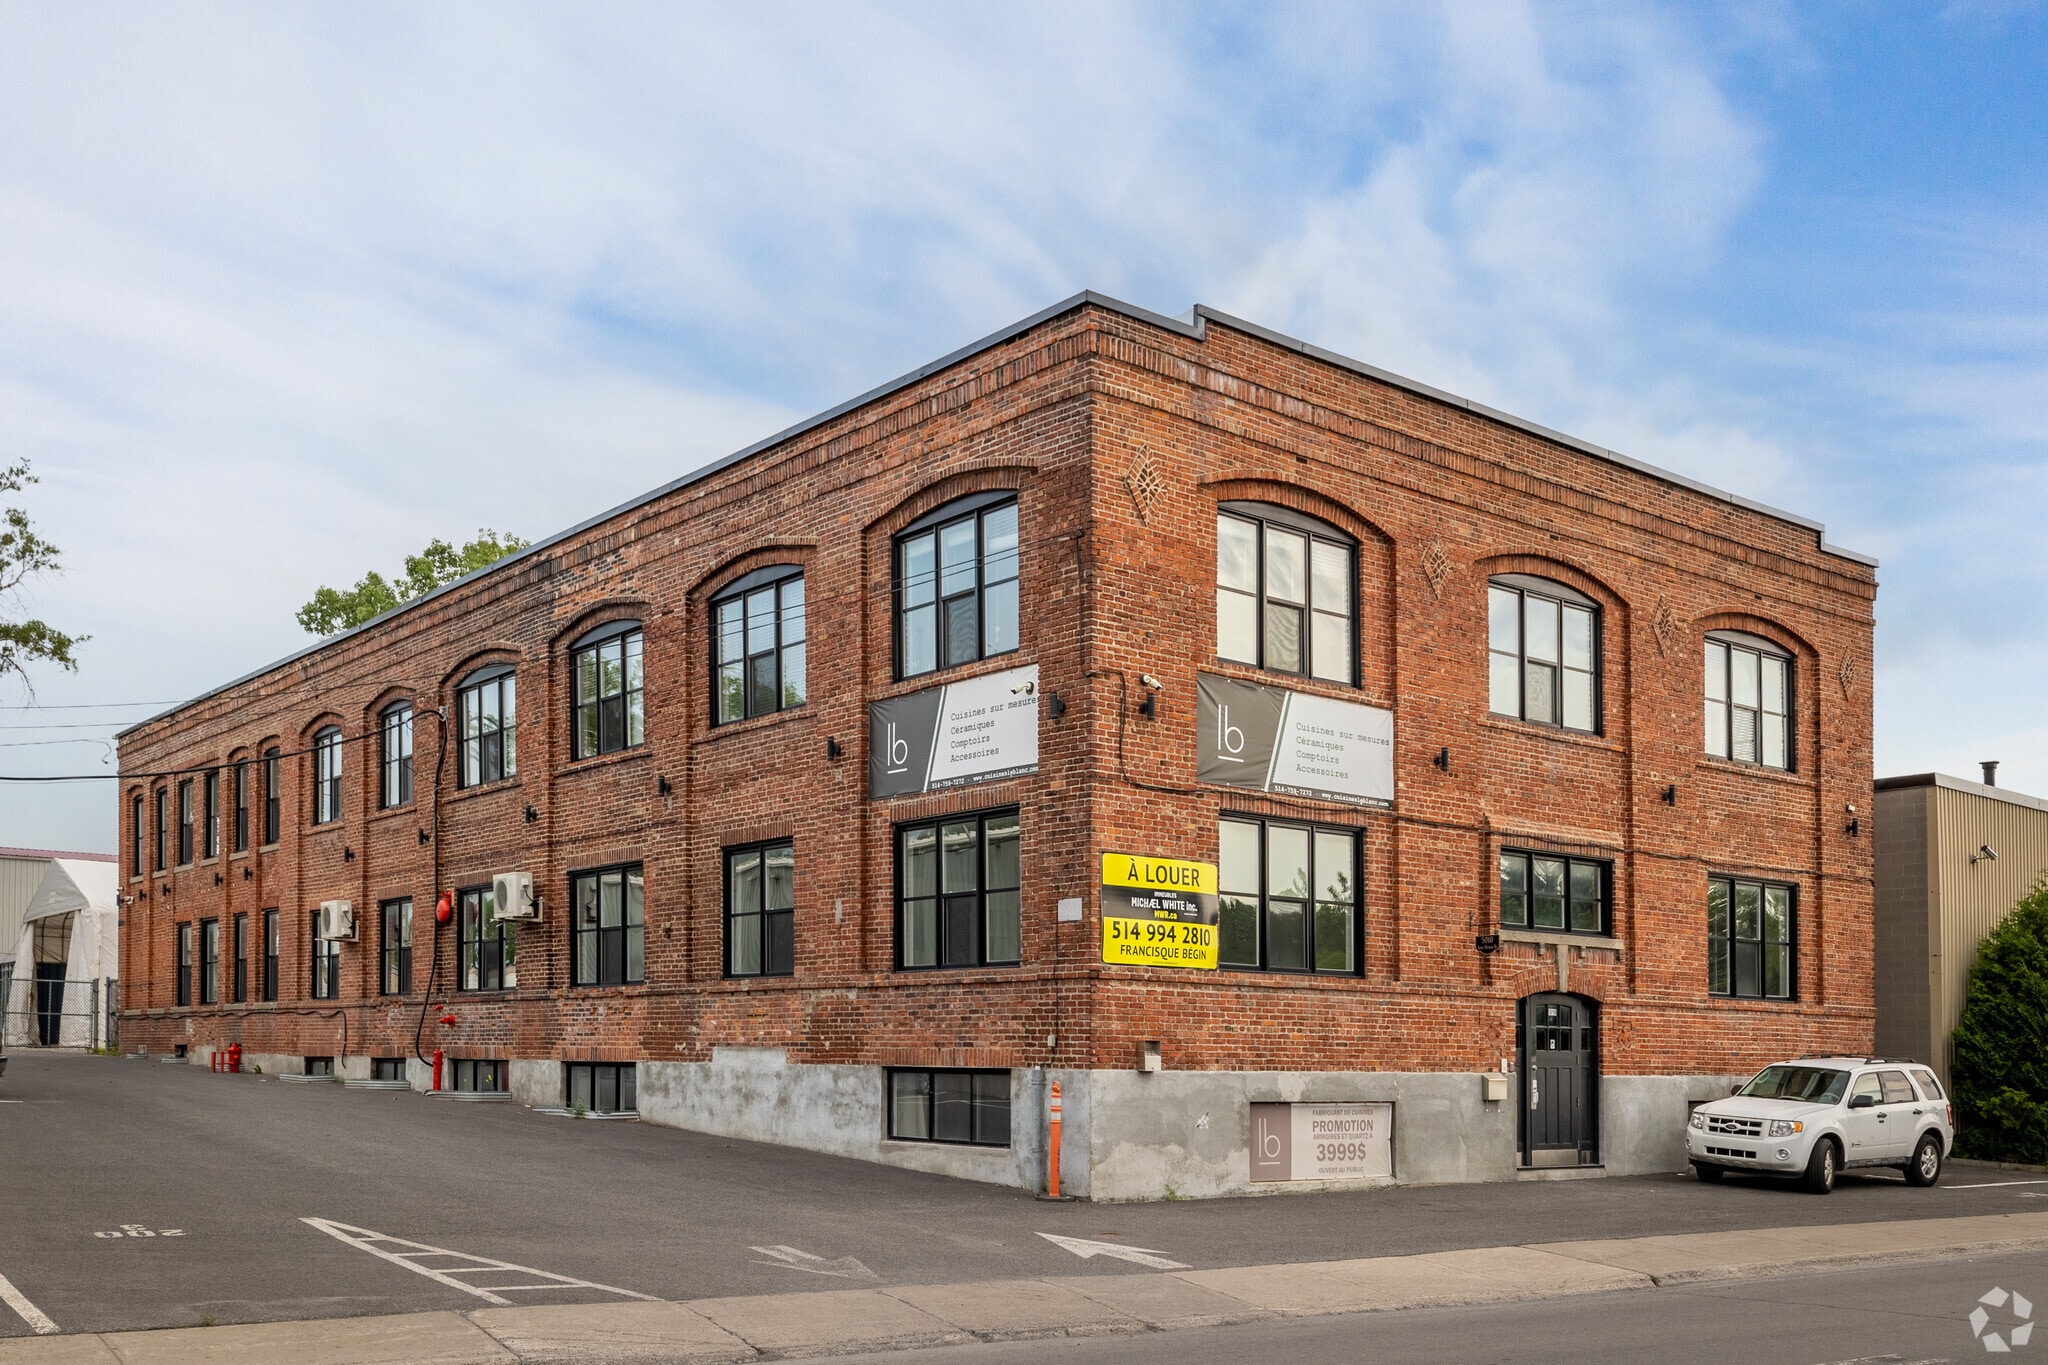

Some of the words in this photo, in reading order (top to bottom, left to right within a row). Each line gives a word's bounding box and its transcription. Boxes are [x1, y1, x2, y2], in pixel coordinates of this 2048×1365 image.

[951, 708, 986, 721] Cuisines
[990, 703, 1004, 713] sur
[951, 735, 991, 750] Comptoirs
[1296, 722, 1335, 737] Cuisines
[1339, 730, 1354, 740] sur
[1357, 734, 1390, 747] mesures
[951, 747, 1000, 763] Accessoires
[1296, 750, 1340, 764] Comptoirs
[1296, 764, 1349, 780] Accessoires
[1127, 858, 1139, 881] À
[1145, 864, 1200, 887] LOUER
[1162, 899, 1185, 911] WHITE
[1186, 901, 1198, 912] inc.
[1112, 921, 1140, 940] 514
[1146, 923, 1176, 943] 994
[1182, 926, 1211, 946] 2810
[1120, 945, 1180, 961] FRANCISQUE
[1182, 947, 1207, 960] BÉGIN
[1312, 1109, 1343, 1117] FABRIQUANT
[1312, 1119, 1374, 1132] PROMOTION
[1348, 1132, 1369, 1140] QUARTZ
[1316, 1141, 1366, 1162] 3999$
